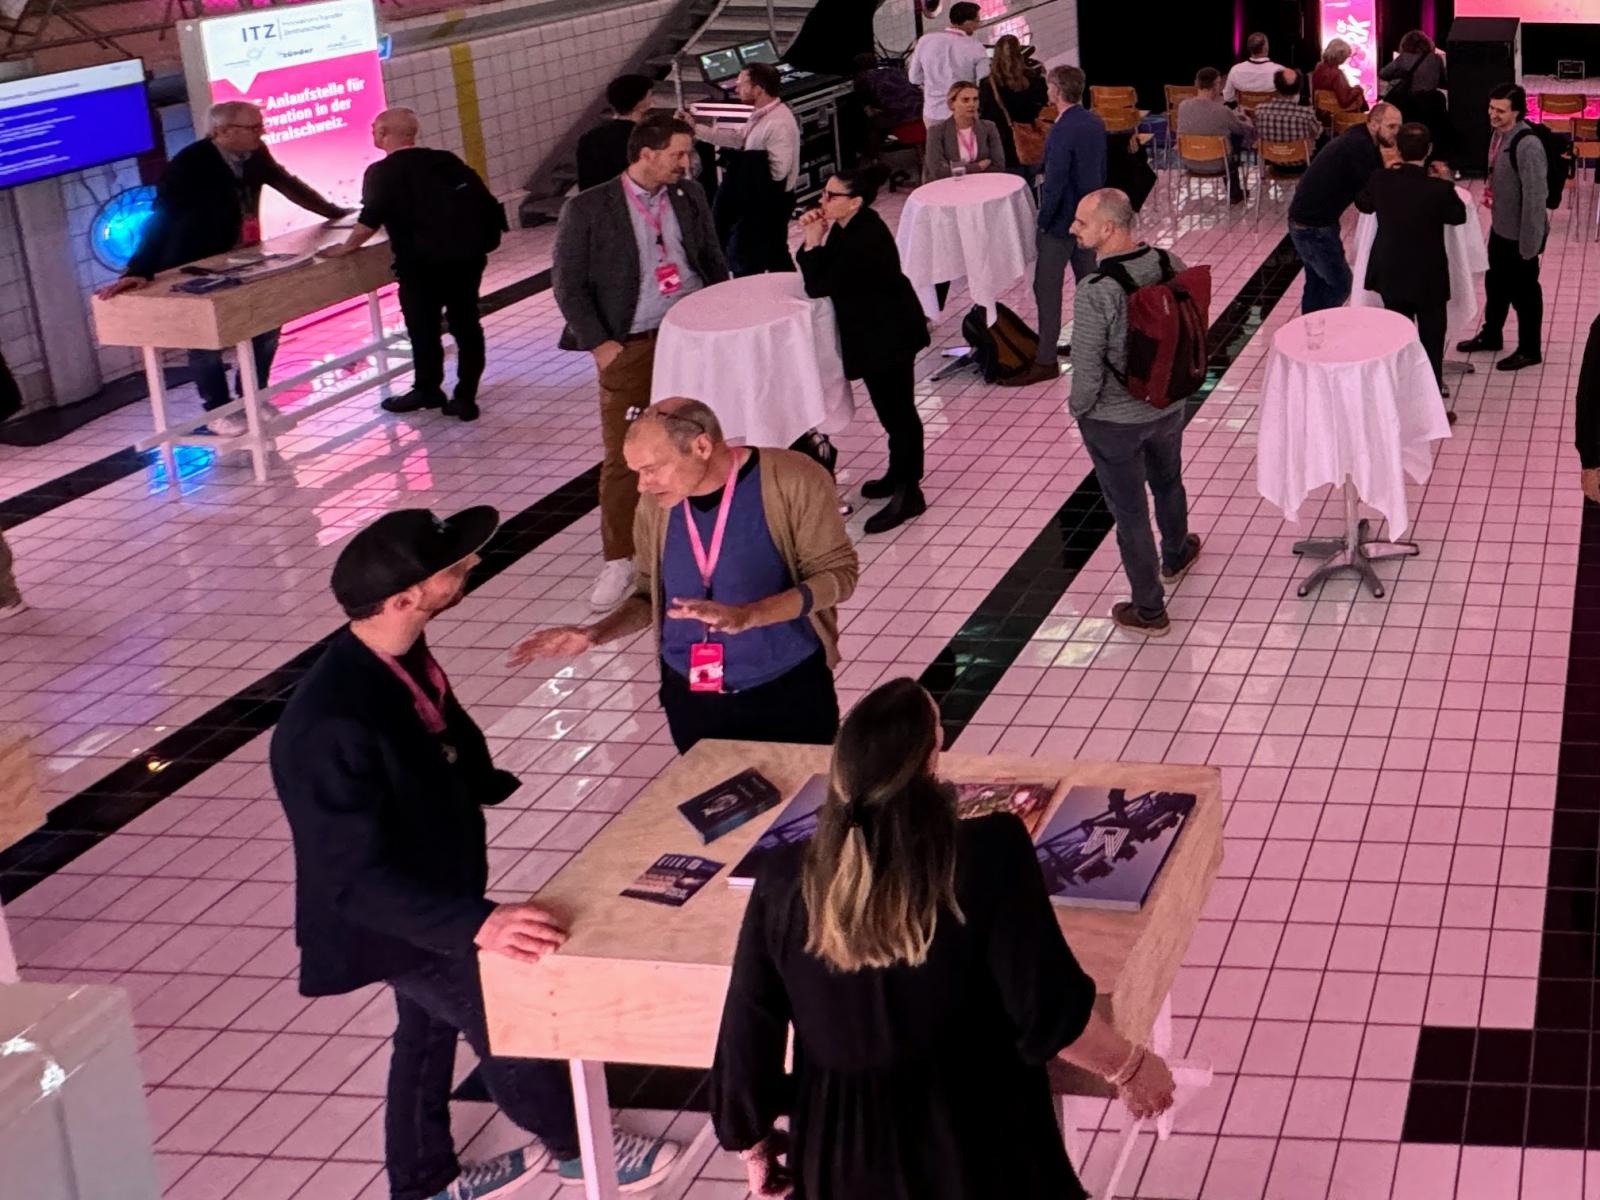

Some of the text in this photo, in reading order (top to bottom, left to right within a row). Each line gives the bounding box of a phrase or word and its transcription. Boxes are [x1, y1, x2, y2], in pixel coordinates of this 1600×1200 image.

[241, 23, 277, 43] ITZ
[266, 77, 365, 110] Anlaufstelle für
[263, 98, 353, 127] ovation in der
